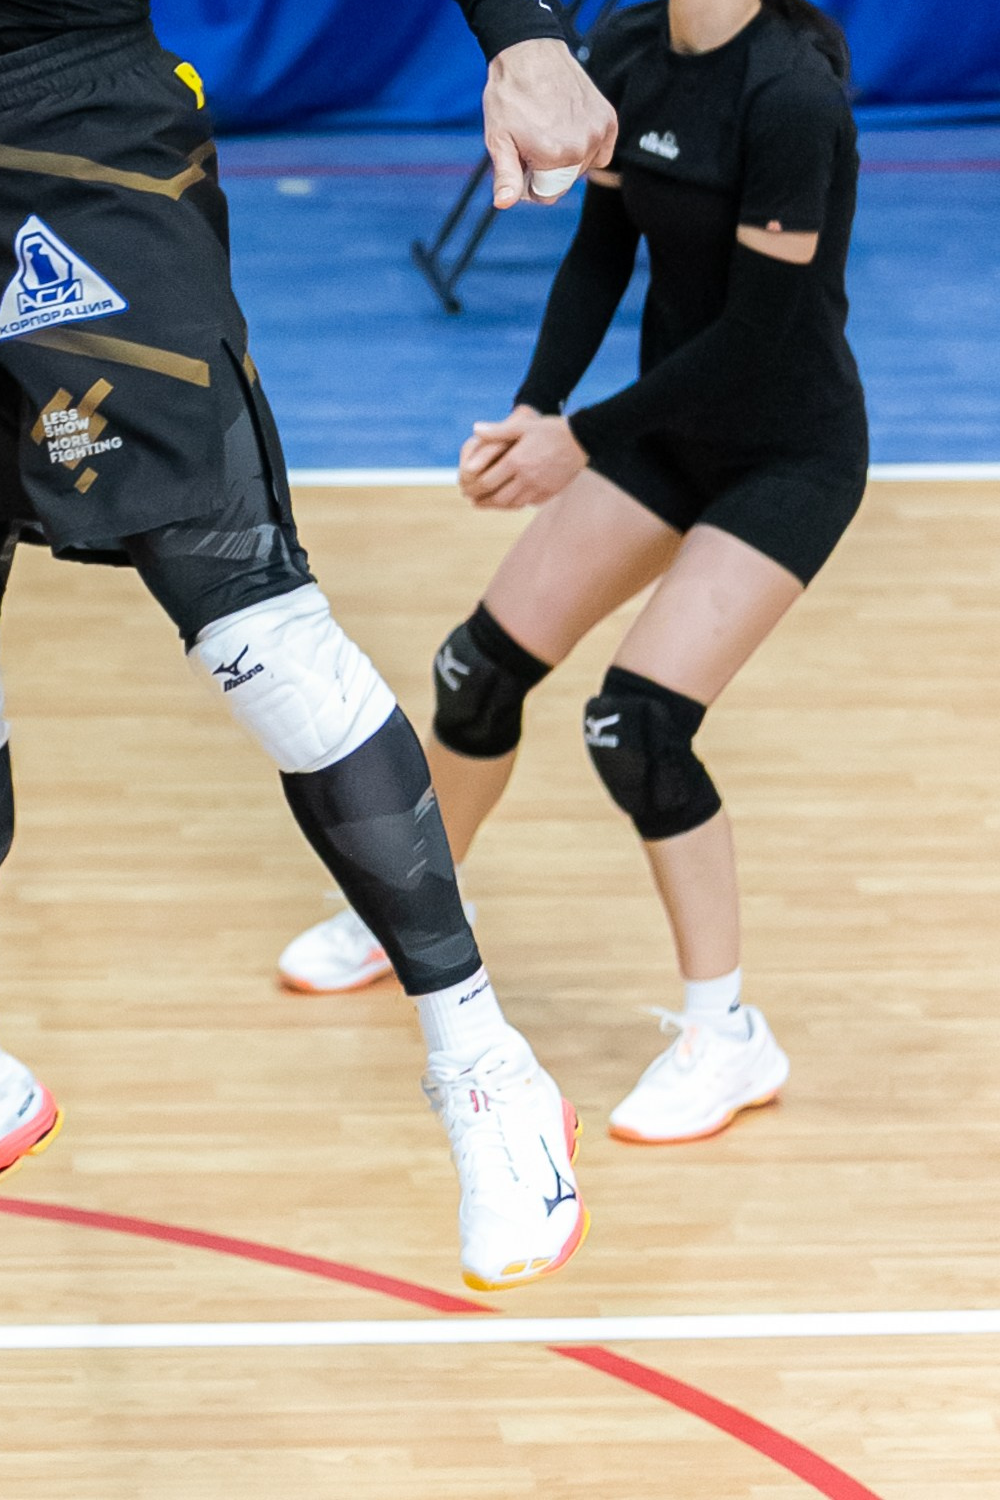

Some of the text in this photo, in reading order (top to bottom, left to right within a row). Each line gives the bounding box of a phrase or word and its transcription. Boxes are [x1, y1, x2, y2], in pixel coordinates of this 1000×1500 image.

[17, 279, 83, 316] АСИ
[0, 299, 114, 335] КОРПОРАЦИЯ
[42, 408, 79, 427] LESS
[44, 416, 90, 438] SHOW
[47, 432, 91, 452] MORE
[49, 436, 123, 464] FIGHTING
